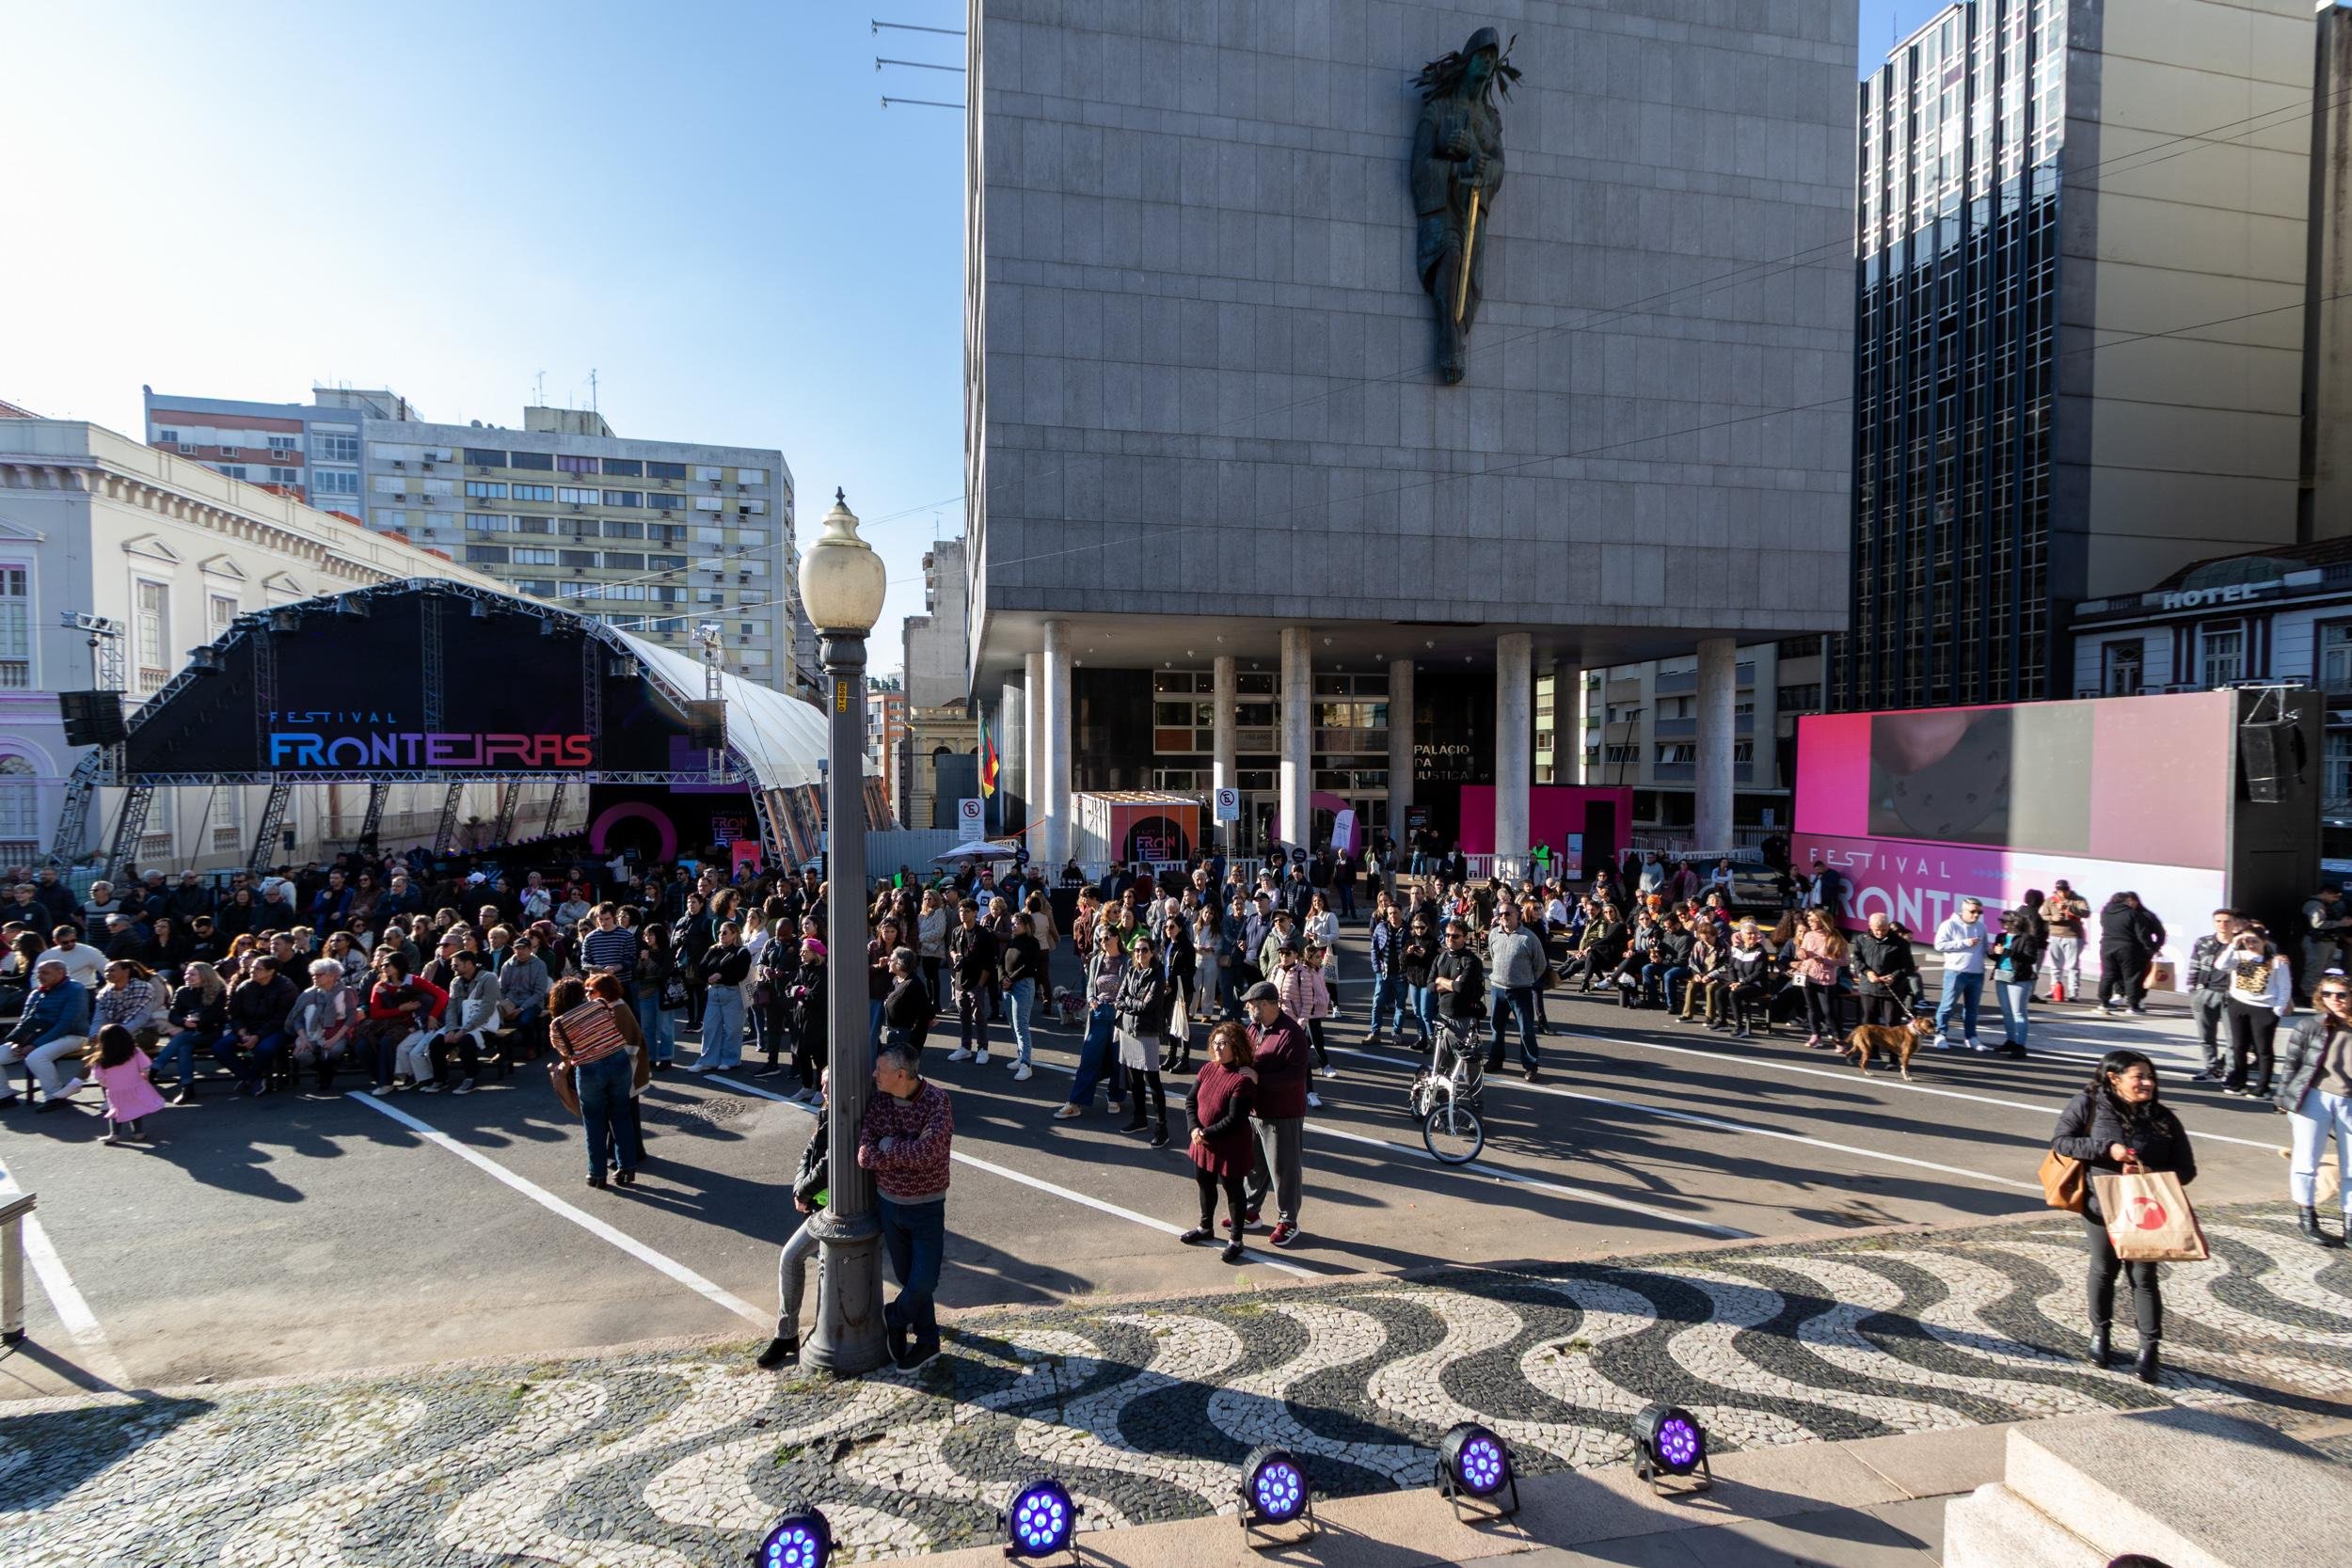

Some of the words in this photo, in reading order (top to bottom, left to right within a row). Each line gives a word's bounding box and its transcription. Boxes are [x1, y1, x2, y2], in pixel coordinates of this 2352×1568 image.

[2163, 582, 2260, 610] HOTEL
[270, 711, 397, 723] FESTIVAL
[270, 731, 593, 767] FRONTEIRAS
[1414, 758, 1433, 768] DA
[1809, 848, 1951, 879] FESTIVAL
